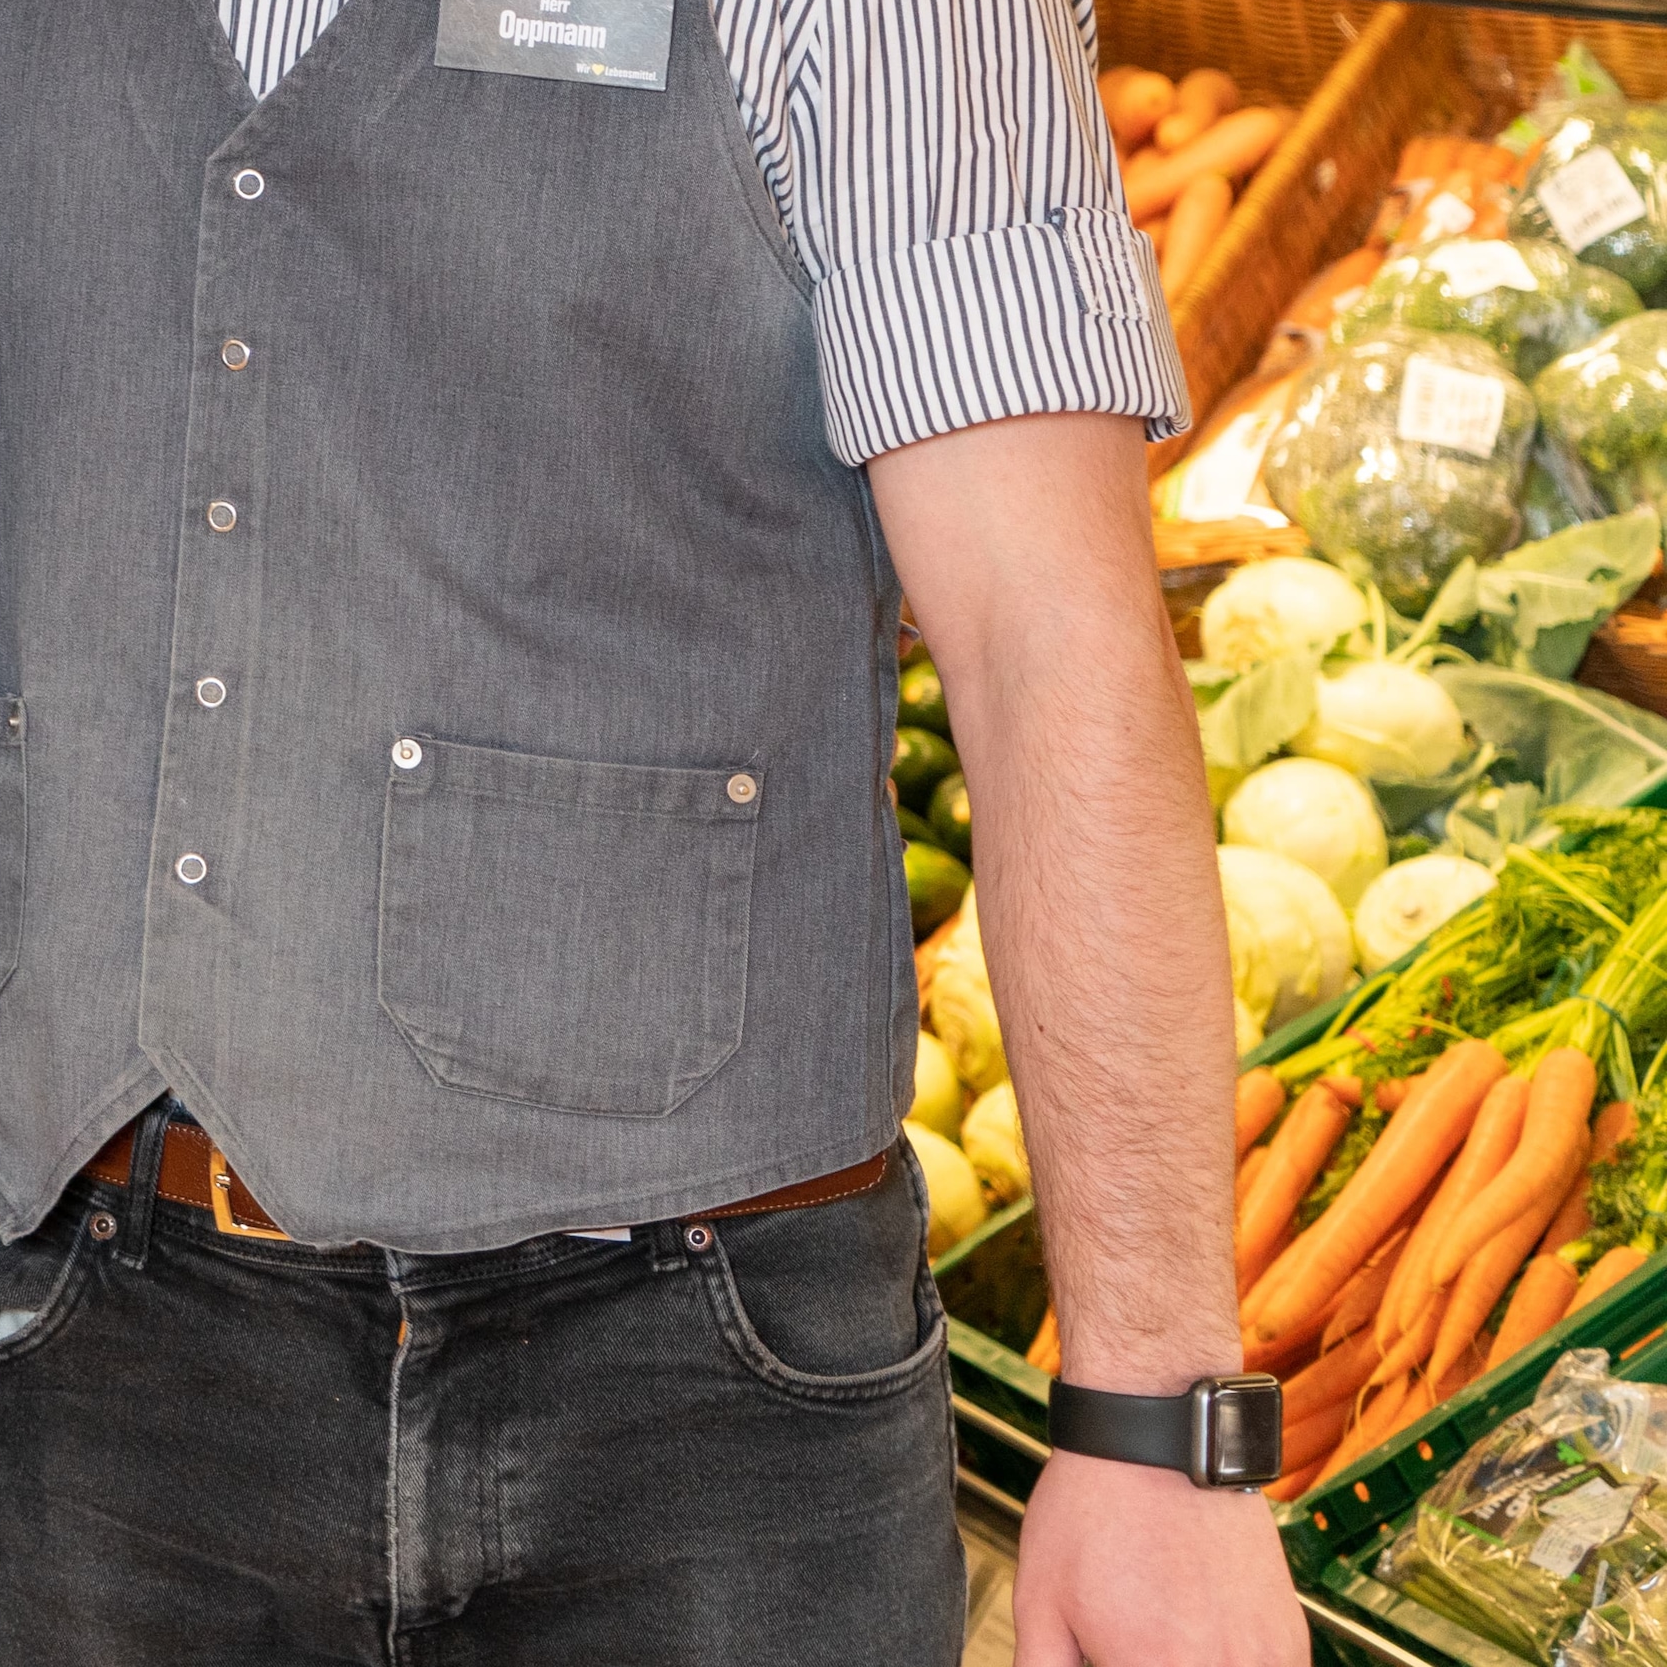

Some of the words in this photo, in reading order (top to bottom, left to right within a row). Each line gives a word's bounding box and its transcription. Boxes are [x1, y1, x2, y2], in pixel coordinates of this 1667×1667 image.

[499, 9, 607, 49] Oppmann
[576, 62, 591, 75] Wir
[604, 66, 659, 82] Lebensmittel.
